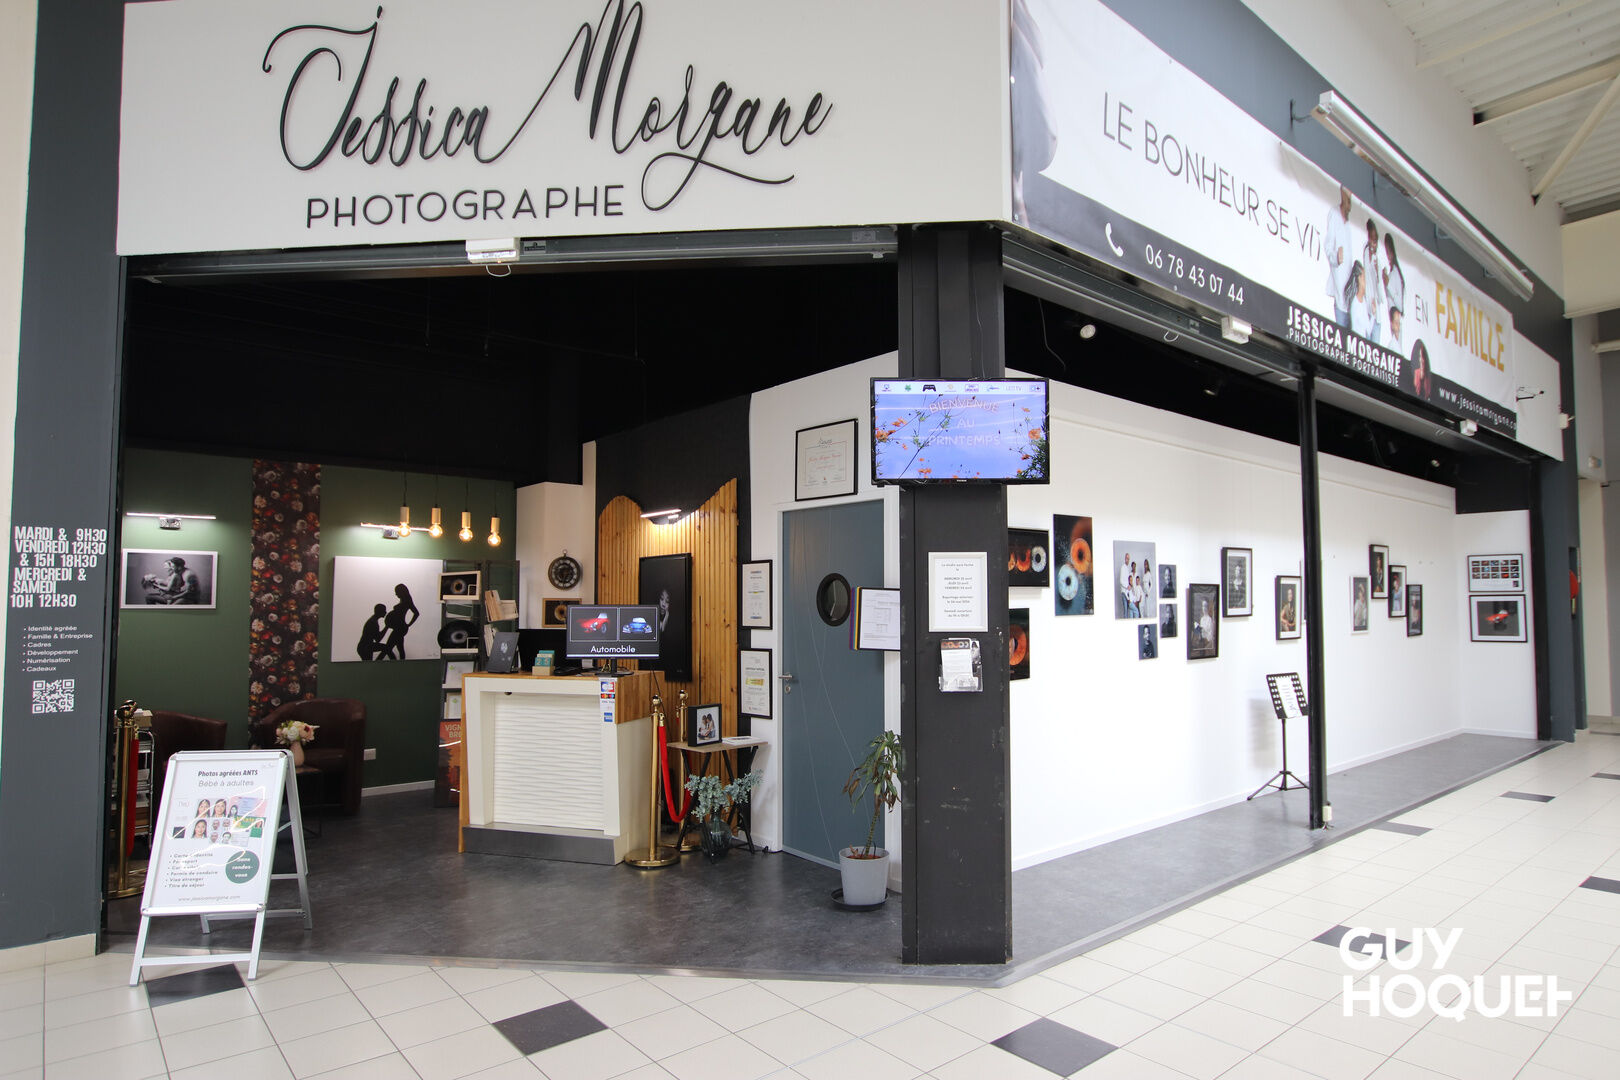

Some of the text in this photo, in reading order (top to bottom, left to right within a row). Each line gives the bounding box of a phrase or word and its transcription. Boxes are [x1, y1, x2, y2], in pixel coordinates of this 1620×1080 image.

[263, 0, 833, 211] Jessica Morgane
[306, 184, 625, 228] PHOTOGRAPHE
[1103, 91, 1133, 151] LE
[1145, 119, 1260, 226] BONHEUR
[1266, 199, 1290, 243] SE
[1415, 294, 1429, 329] EN
[1435, 280, 1505, 372] FAMILLE
[1145, 243, 1245, 305] 06 78 43 07 44
[1286, 305, 1401, 376] JESSICA MORGANE
[1352, 356, 1399, 387] PORTRAITISTE
[929, 399, 1000, 414] BIENVENUE
[957, 417, 975, 428] AU
[929, 434, 1000, 446] PRINTEMPS
[14, 525, 107, 541] MARDI & 9H30
[15, 539, 107, 555] VENDREDI 12H30
[20, 552, 98, 568] & 15H 18H30
[14, 567, 87, 581] MERCREDI &
[13, 580, 57, 594] SAMEDI
[10, 594, 77, 608] 10H 12H30
[54, 625, 78, 634] agréée
[60, 632, 94, 640] Entreprise
[27, 648, 79, 656] Développement
[590, 643, 637, 655] Automobile
[26, 657, 71, 665] Numérisation
[26, 665, 57, 673] Cadeaux
[219, 769, 242, 778] agréées
[198, 779, 219, 787] Bébé
[226, 779, 255, 787] adultes
